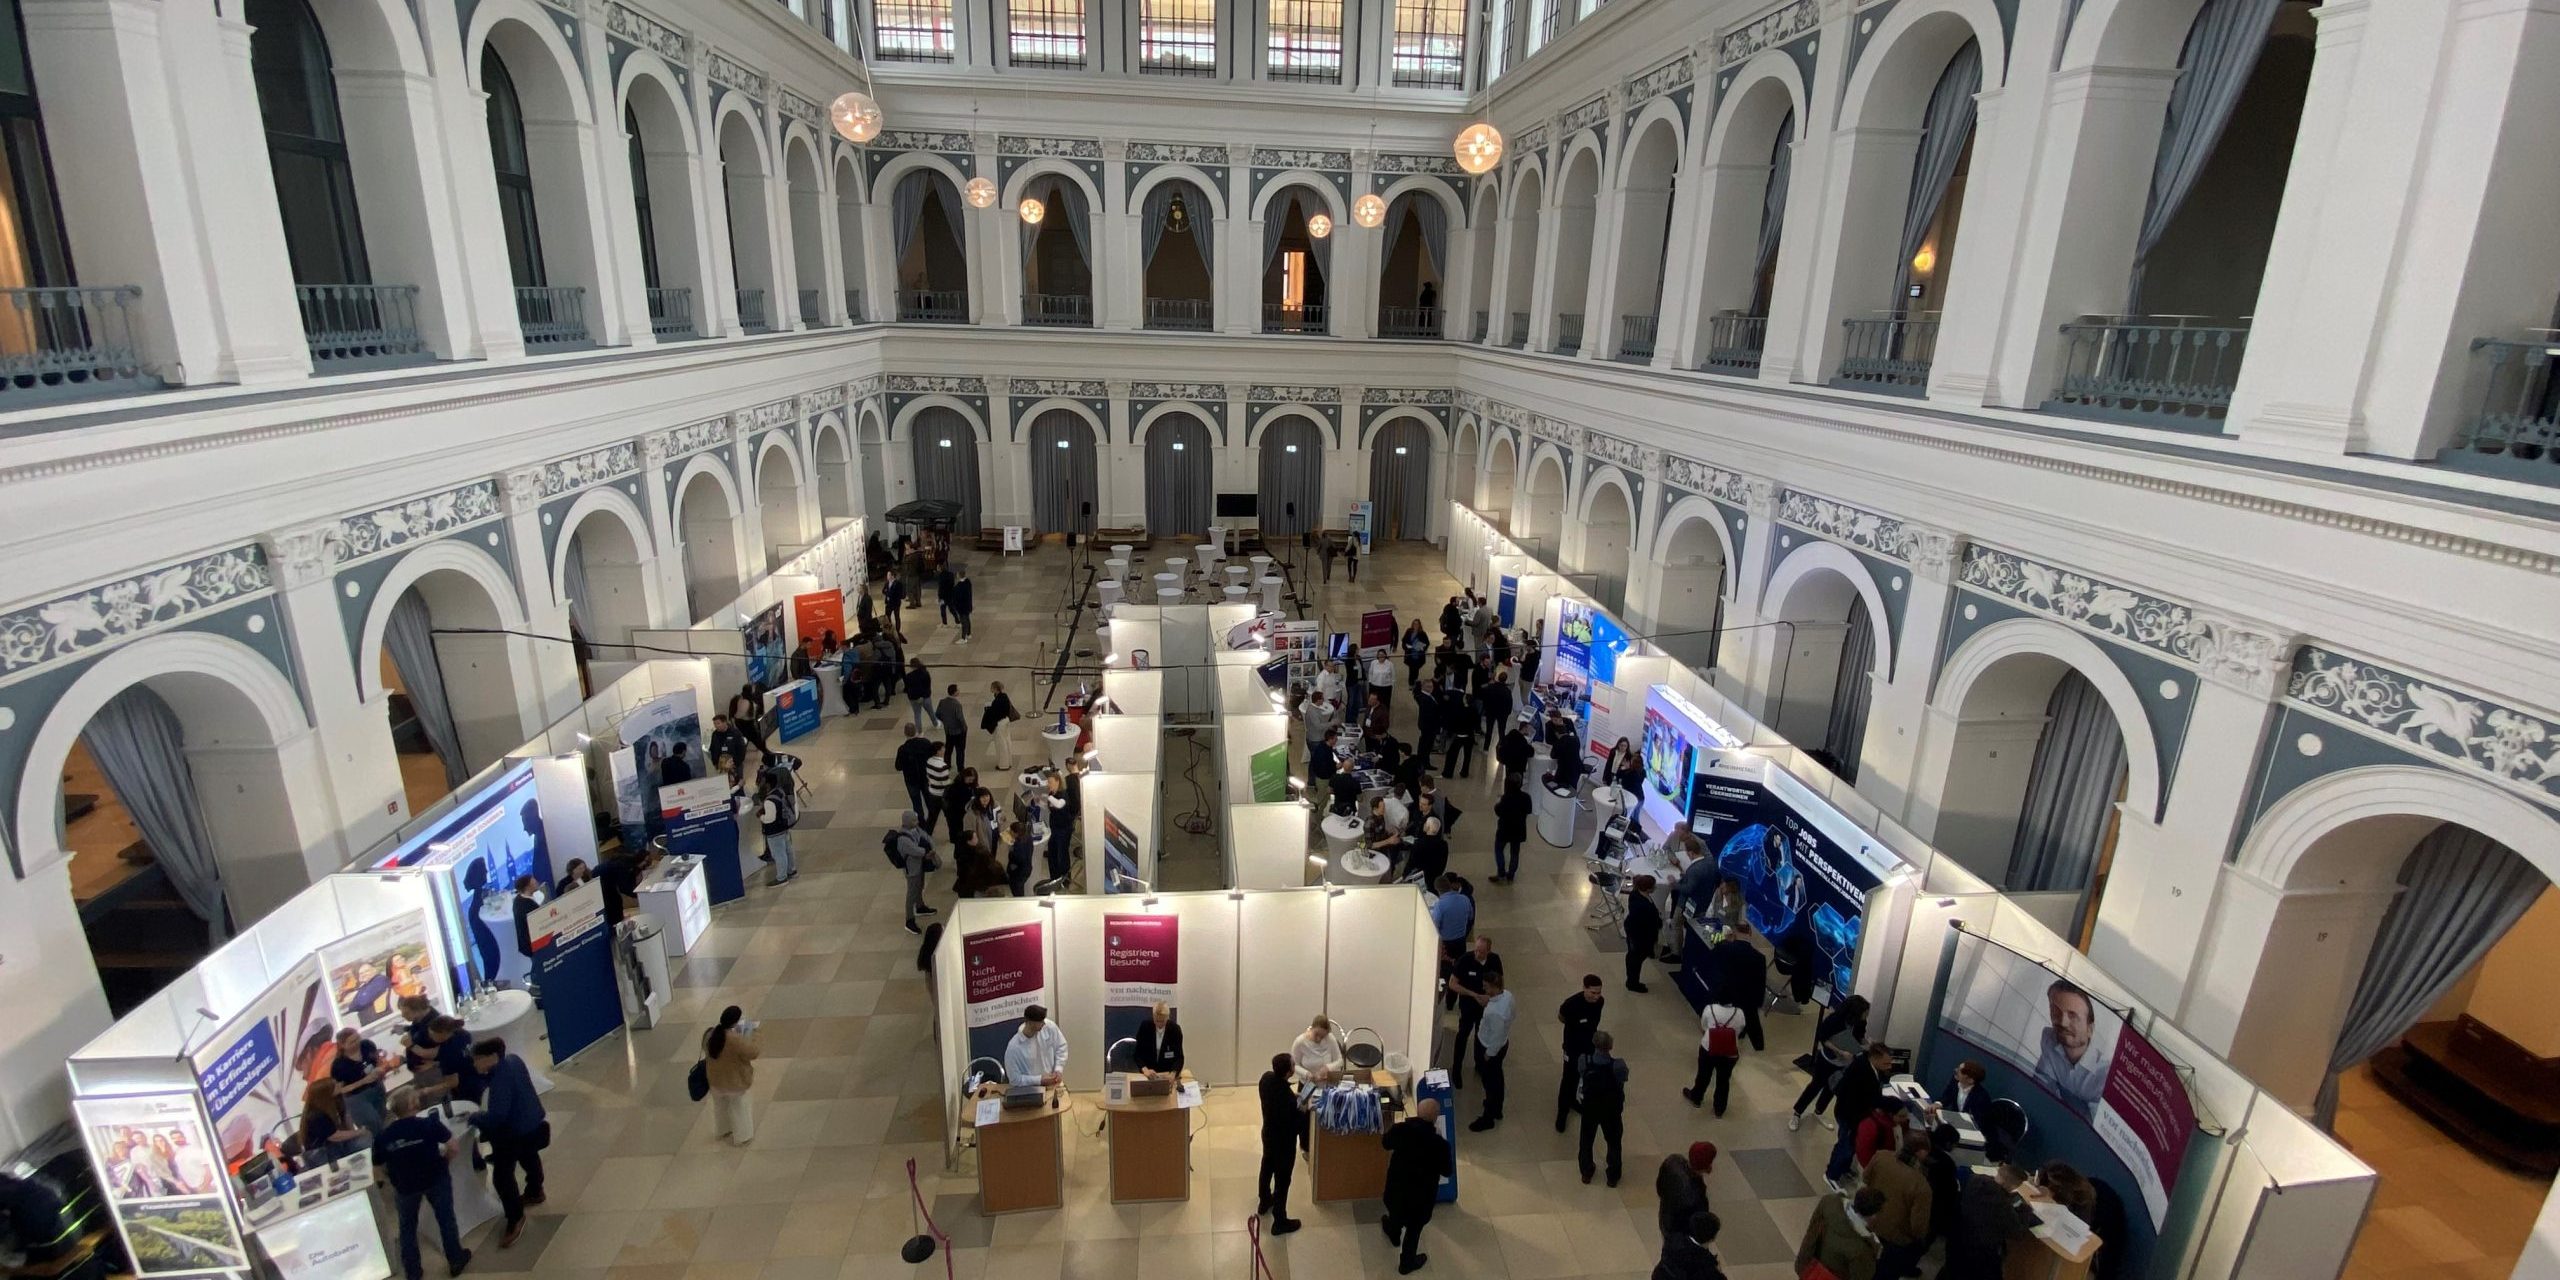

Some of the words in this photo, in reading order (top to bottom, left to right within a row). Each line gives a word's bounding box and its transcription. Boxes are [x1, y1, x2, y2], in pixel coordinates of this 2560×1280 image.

[1705, 784, 1755, 796] VERANTWORTUNG
[1785, 815, 1798, 831] TOP
[1799, 828, 1817, 848] JOBS
[1795, 838, 1808, 854] MIT
[1809, 849, 1865, 904] PERSPEKTIVEN
[1110, 949, 1160, 959] Registrierte
[1110, 958, 1151, 967] Besucher
[971, 966, 997, 978] Nicht
[972, 970, 1023, 987] registrierte
[973, 981, 1016, 996] Besucher
[1126, 985, 1172, 995] nachrichten
[991, 995, 1039, 1011] nachrichten
[2124, 1038, 2140, 1058] Wir
[215, 1039, 254, 1076] Karriere
[219, 1053, 256, 1091] Erfinder
